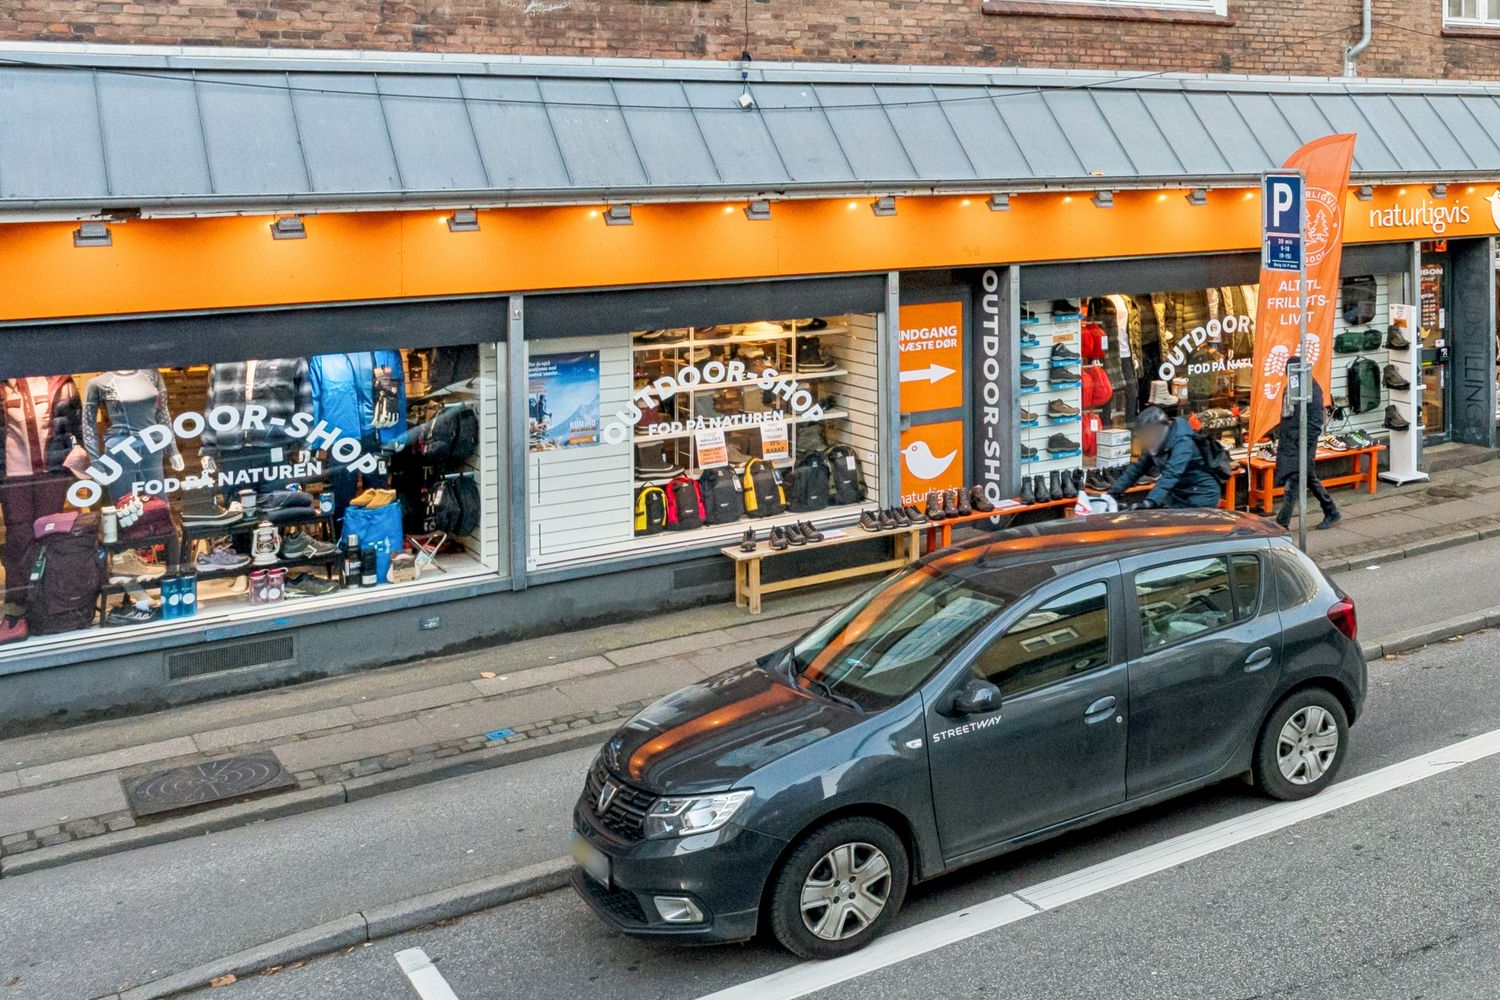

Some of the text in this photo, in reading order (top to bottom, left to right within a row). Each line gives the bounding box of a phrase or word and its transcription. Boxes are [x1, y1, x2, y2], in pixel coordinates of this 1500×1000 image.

[1273, 183, 1293, 227] P
[1369, 199, 1470, 233] naturligvis
[1279, 280, 1300, 292] ALT
[1280, 311, 1315, 326] LIVT
[898, 338, 958, 353] NÆSTE DØR
[1188, 363, 1210, 375] FOD
[1212, 357, 1225, 372] PÅ
[602, 360, 824, 445] OUTDOOR-SHOP
[648, 410, 784, 436] FOD PÅ NATUREN
[66, 404, 378, 508] OUTDOOR-SHOP
[132, 461, 322, 497] FOD PÅ NATUREN
[932, 715, 1002, 743] STREETWAY
